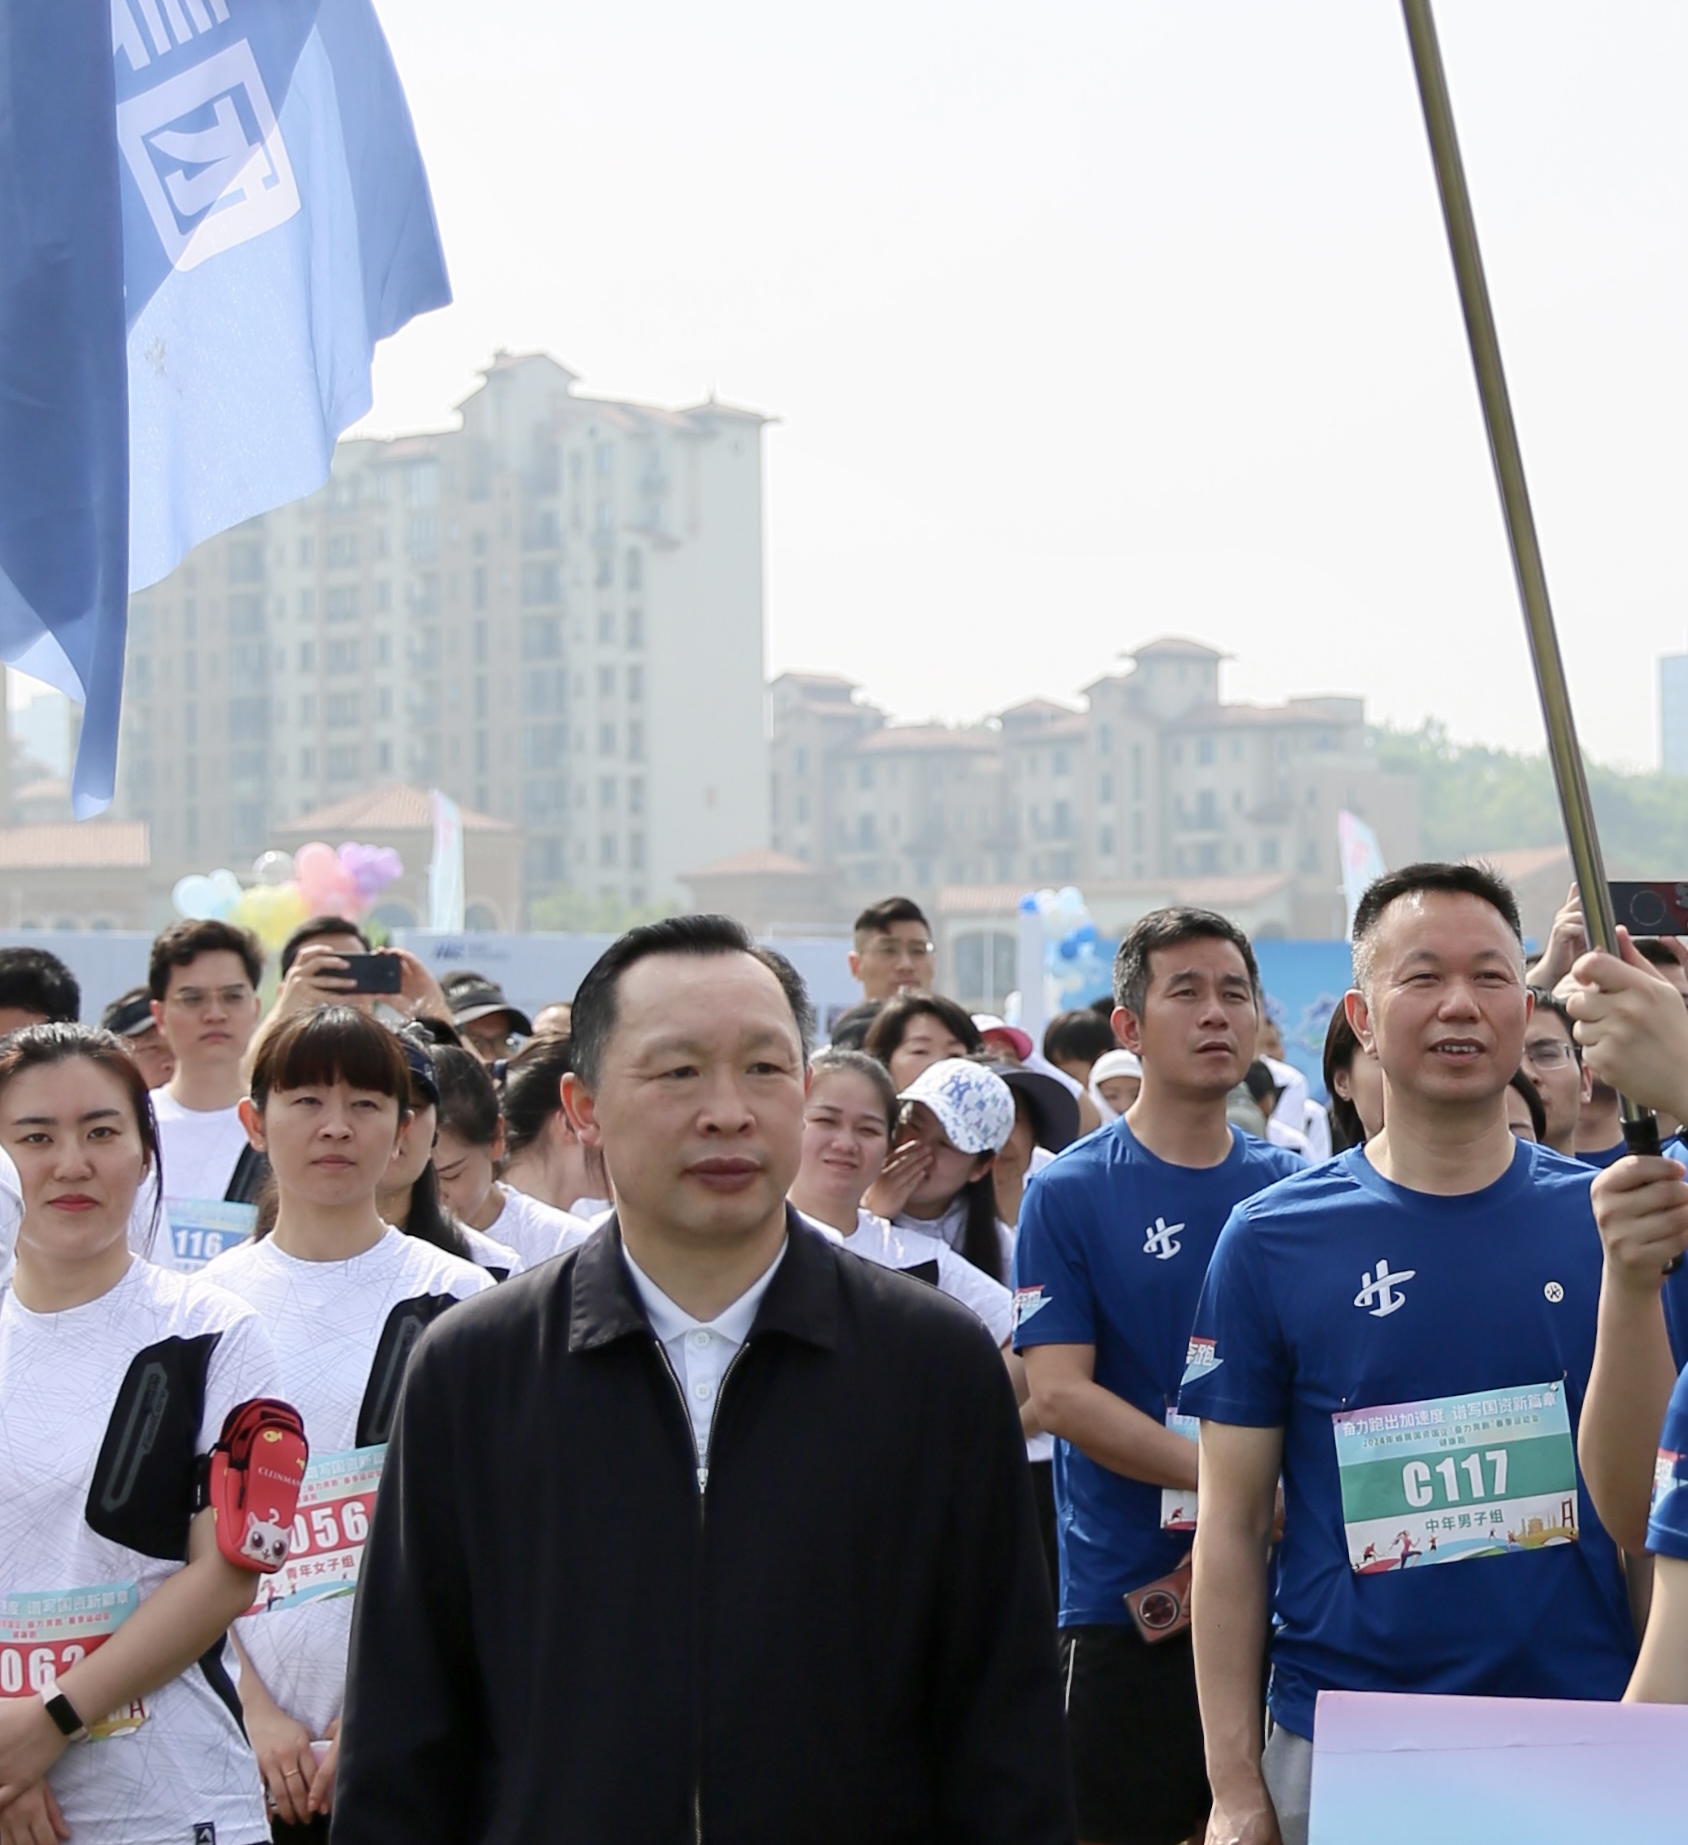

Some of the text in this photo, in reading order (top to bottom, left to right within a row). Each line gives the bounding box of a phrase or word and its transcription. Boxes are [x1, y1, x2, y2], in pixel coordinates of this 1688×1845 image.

[1342, 1392, 1558, 1437] 奋力跑出加速度 谱写国资新篇章
[1402, 1448, 1508, 1508] C117
[1425, 1508, 1505, 1533] 中年男子组
[286, 1555, 355, 1580] 青年女子组
